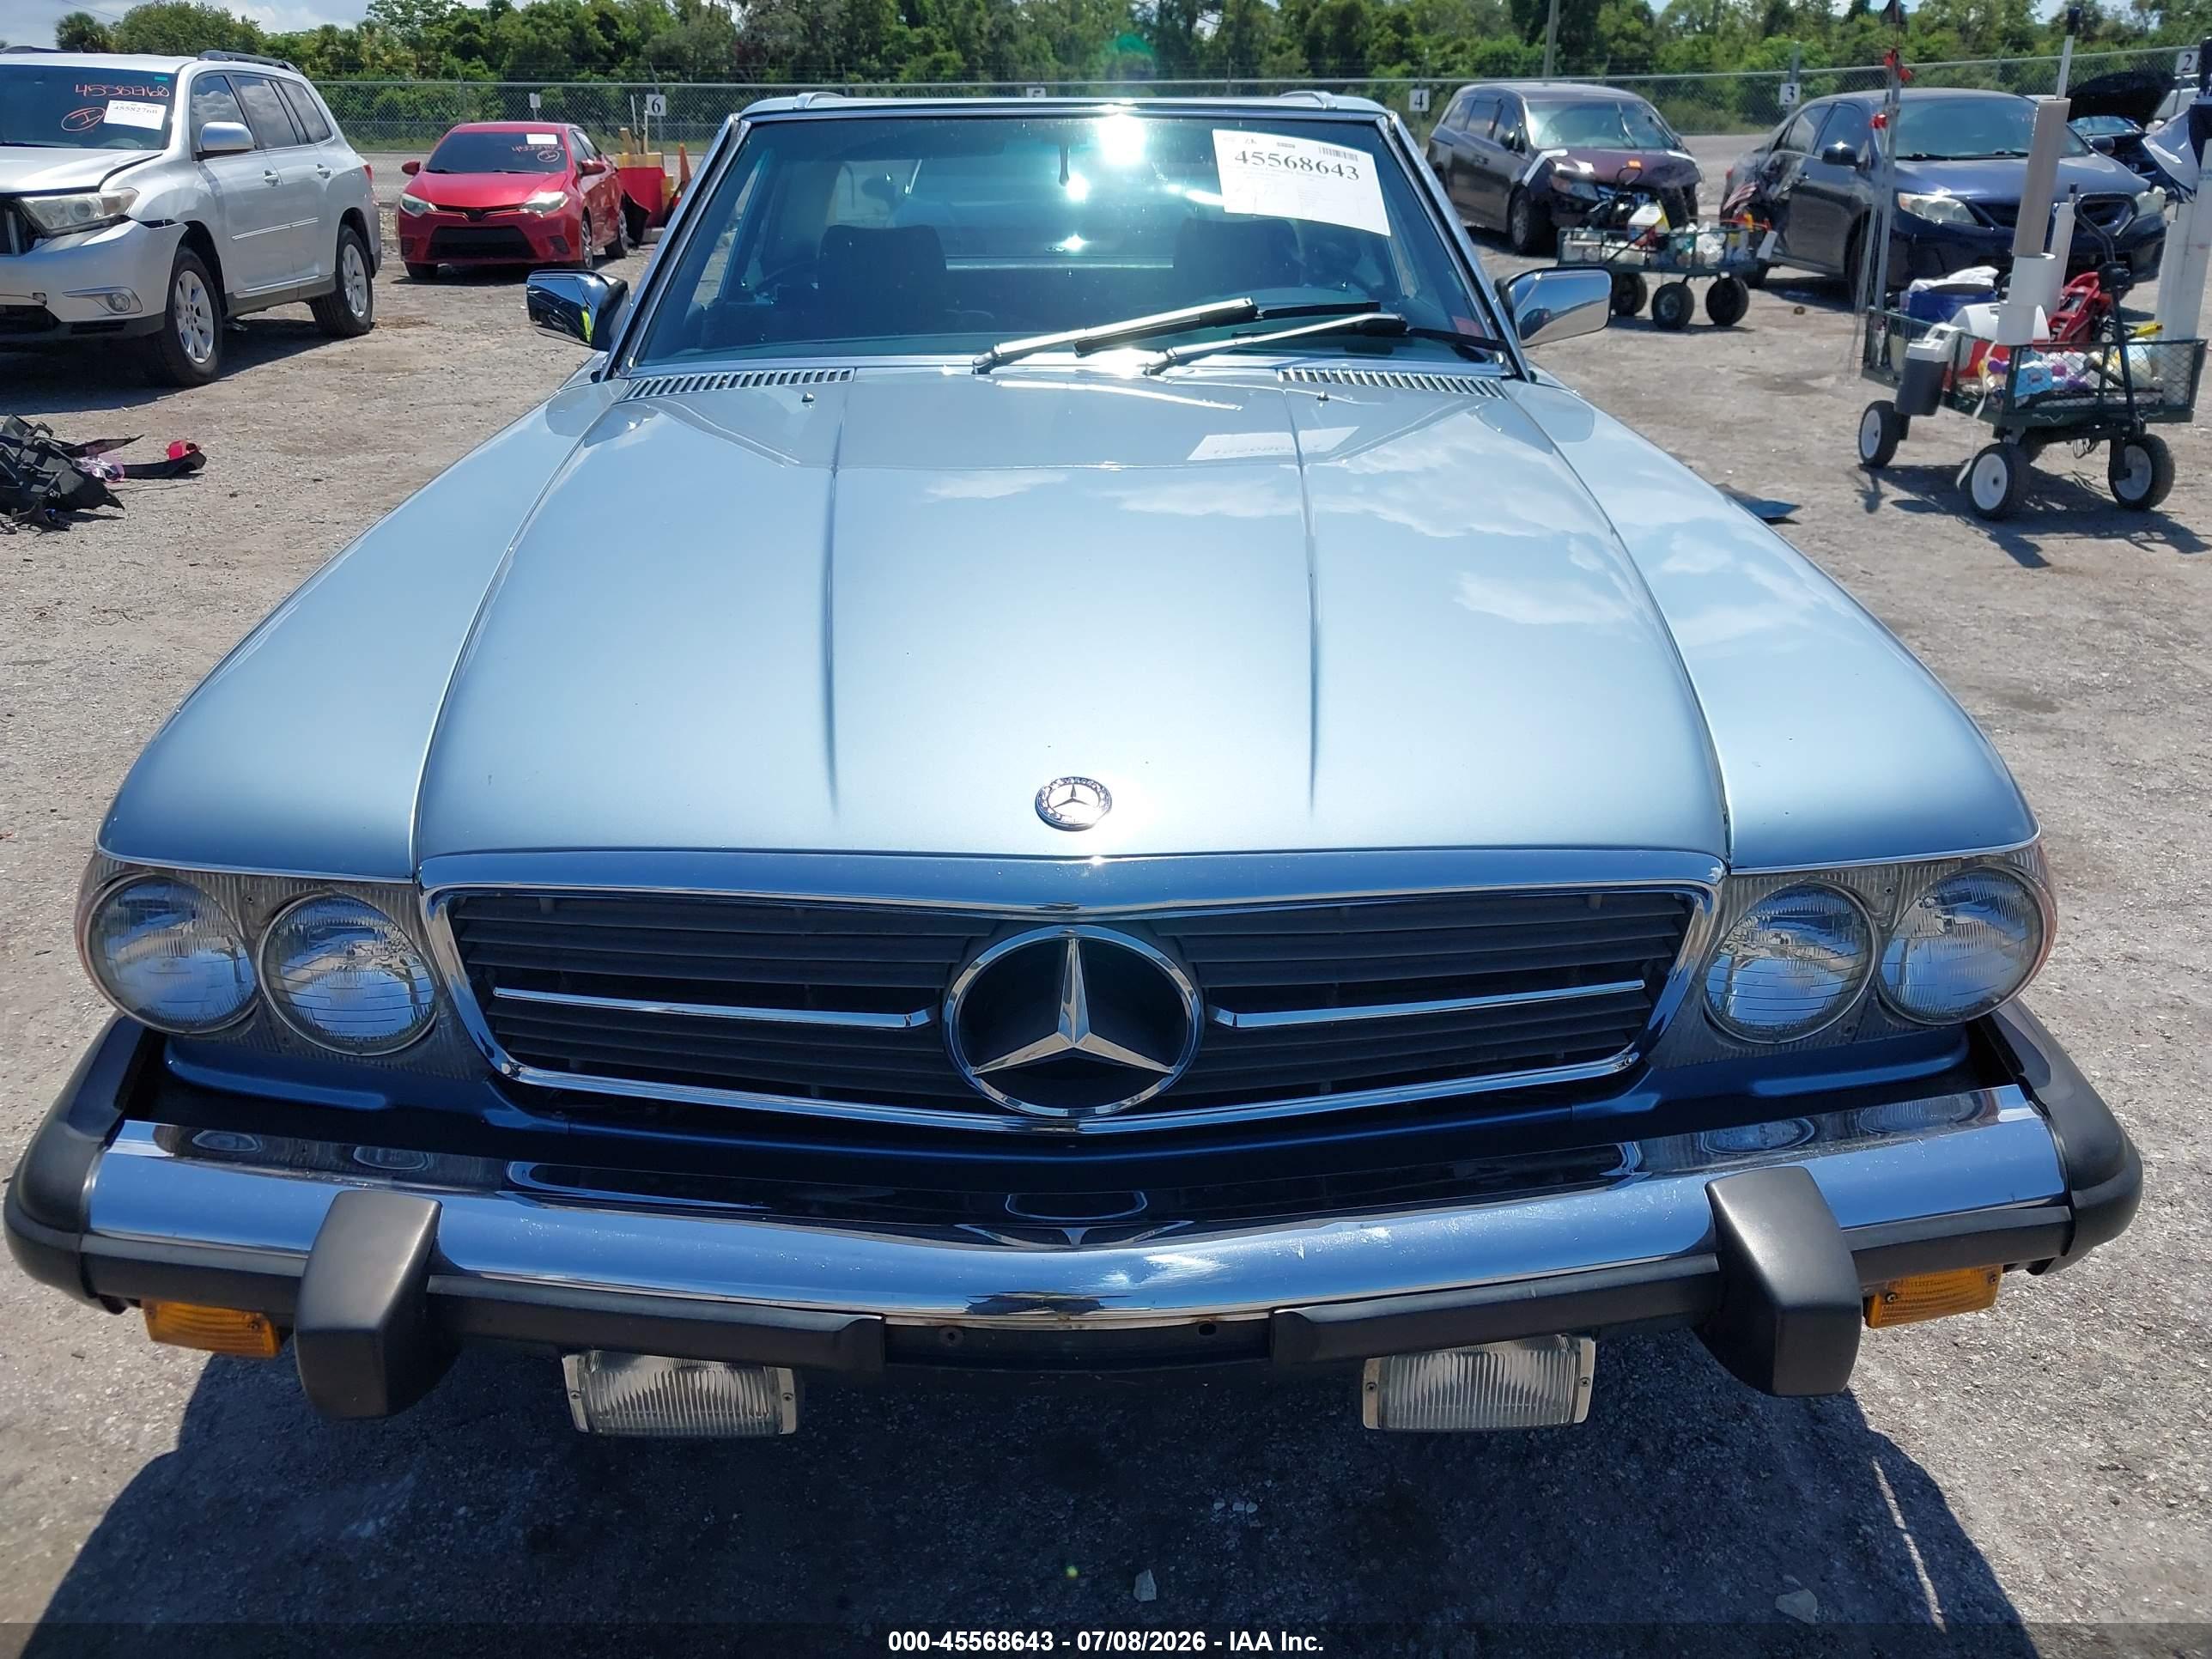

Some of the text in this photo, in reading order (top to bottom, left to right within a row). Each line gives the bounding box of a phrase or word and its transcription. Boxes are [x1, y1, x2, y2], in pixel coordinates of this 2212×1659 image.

[2181, 53, 2193, 71] 2
[1414, 92, 1424, 108] 4
[1784, 86, 1795, 102] 3
[651, 97, 661, 114] 6
[1235, 150, 1360, 181] 45568643
